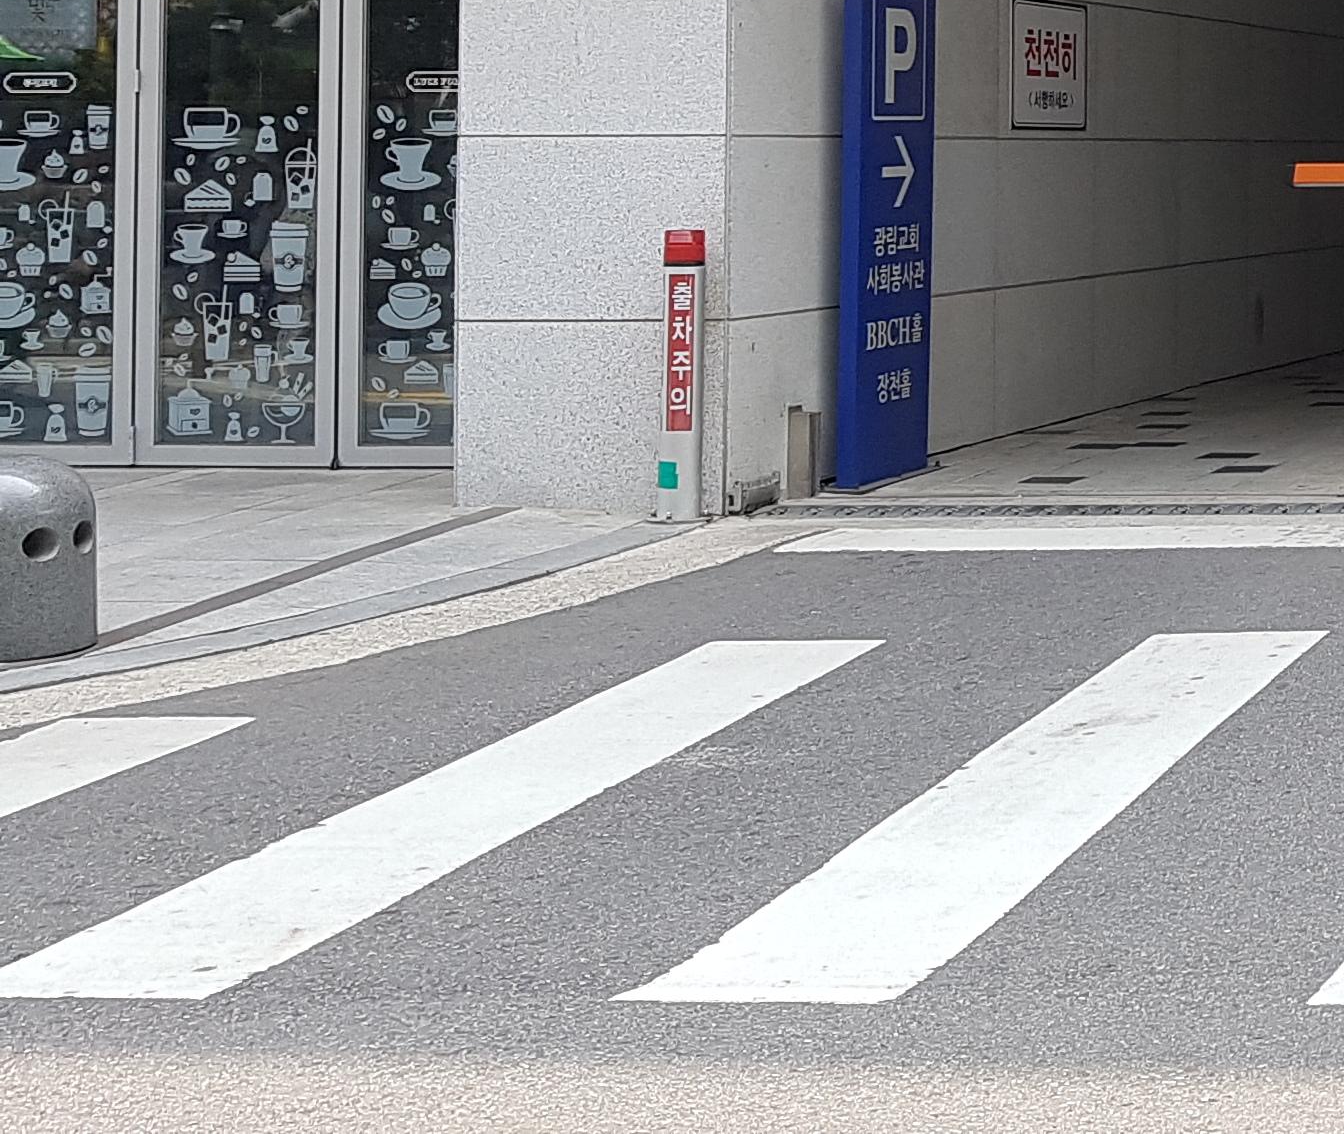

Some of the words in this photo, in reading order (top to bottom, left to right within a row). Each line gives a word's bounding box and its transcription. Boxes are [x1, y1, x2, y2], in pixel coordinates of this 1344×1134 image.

[884, 7, 917, 104] P
[1025, 29, 1077, 81] 천천히
[873, 223, 920, 257] 광림교회
[866, 259, 926, 296] 사회봉사관
[669, 281, 694, 415] 출차주의
[866, 312, 924, 351] BBCH홀
[876, 368, 912, 404] 장천홀
